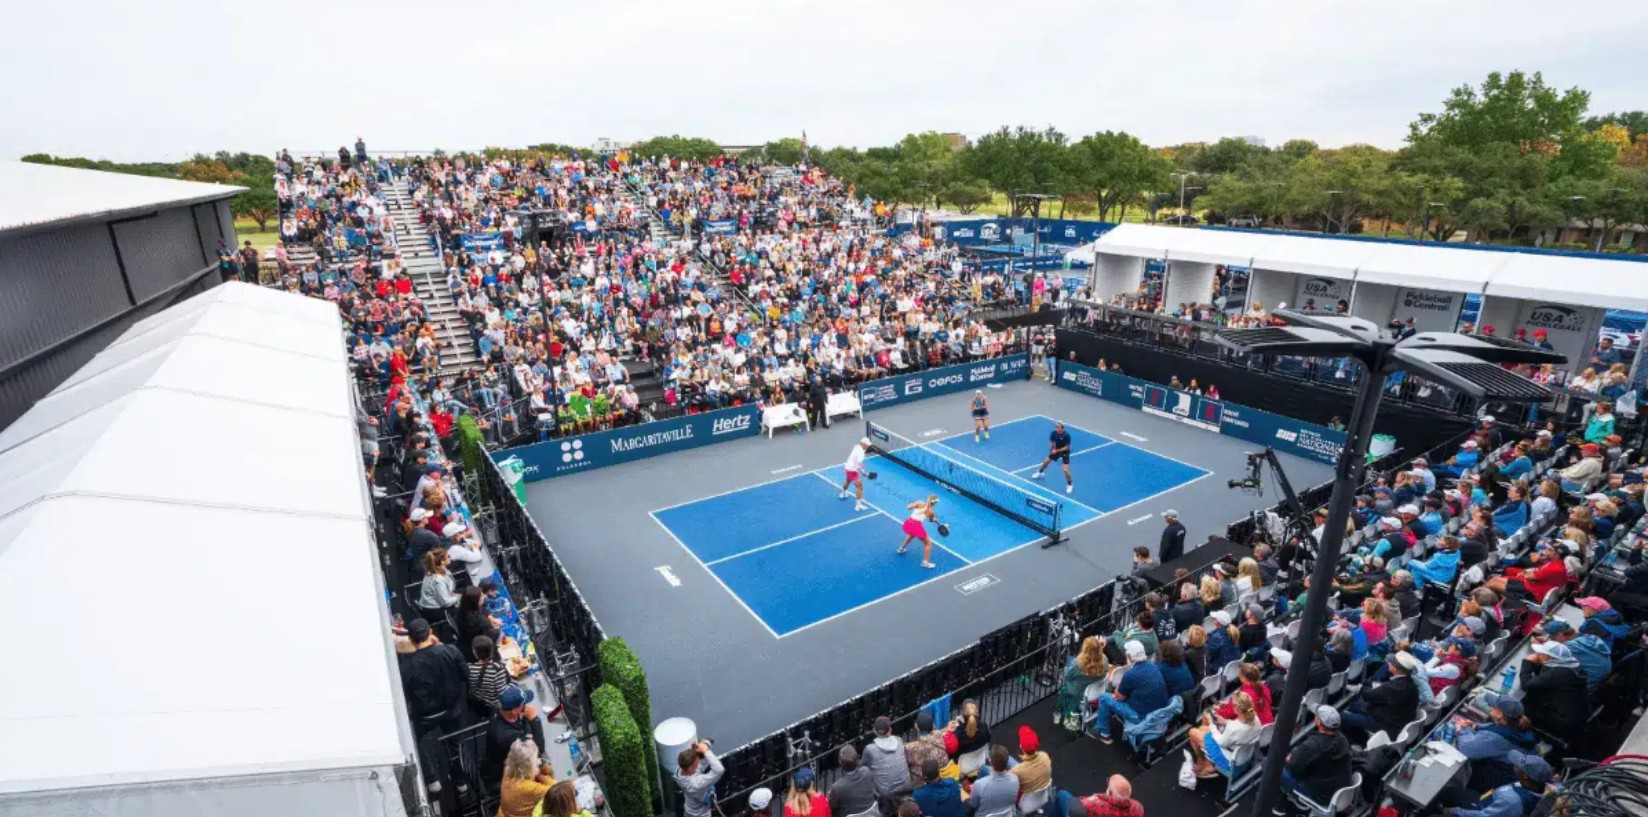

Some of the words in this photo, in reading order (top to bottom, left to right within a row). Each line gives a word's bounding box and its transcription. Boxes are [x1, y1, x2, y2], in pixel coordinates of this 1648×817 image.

[1406, 291, 1453, 304] Pickleball
[1531, 310, 1564, 324] USA
[712, 414, 751, 433] Hertz
[610, 424, 694, 453] MARGARITAVILLE
